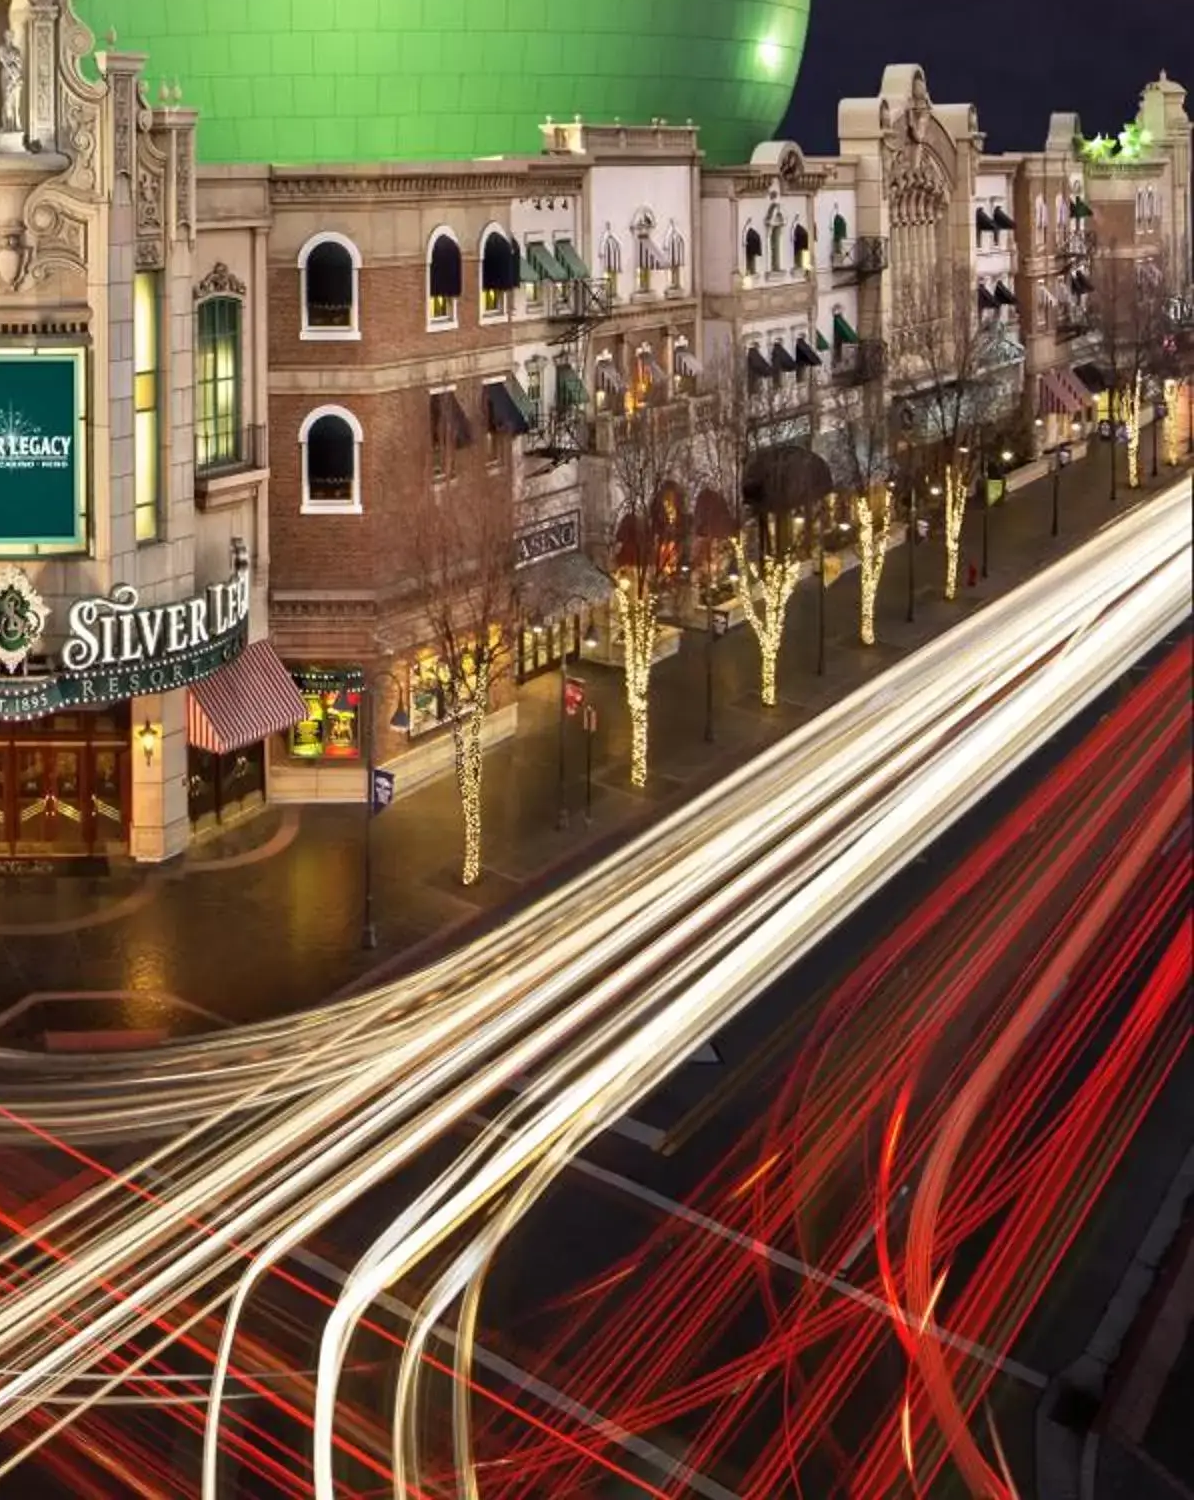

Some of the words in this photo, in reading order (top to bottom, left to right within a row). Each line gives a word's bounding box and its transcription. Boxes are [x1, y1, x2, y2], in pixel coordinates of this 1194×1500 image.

[8, 435, 71, 455] LEGACY
[63, 584, 209, 670] SILVER
[82, 658, 203, 697] RESORT
[15, 693, 48, 712] 1895
